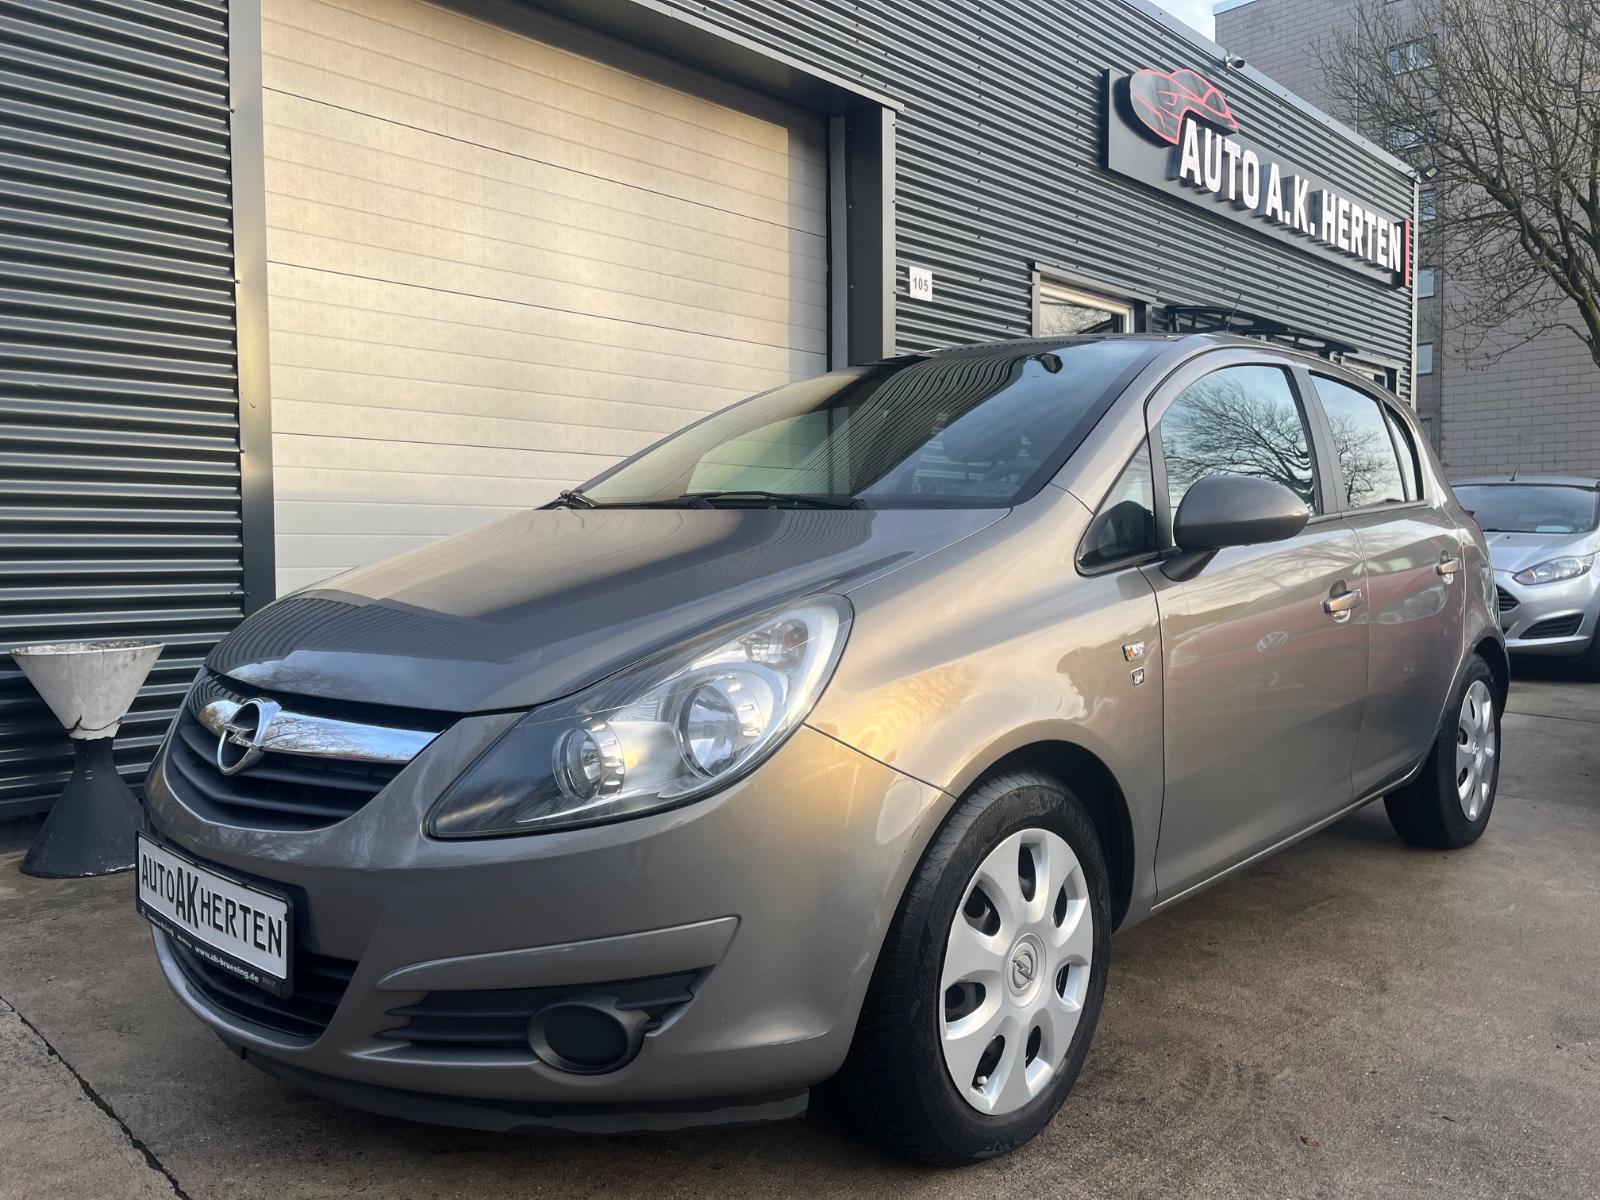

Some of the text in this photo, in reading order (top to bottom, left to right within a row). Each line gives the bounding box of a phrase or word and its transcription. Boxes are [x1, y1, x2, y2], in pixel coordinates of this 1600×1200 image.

[1179, 117, 1402, 273] AUTO A.K. HERTEN
[913, 276, 929, 292] 105
